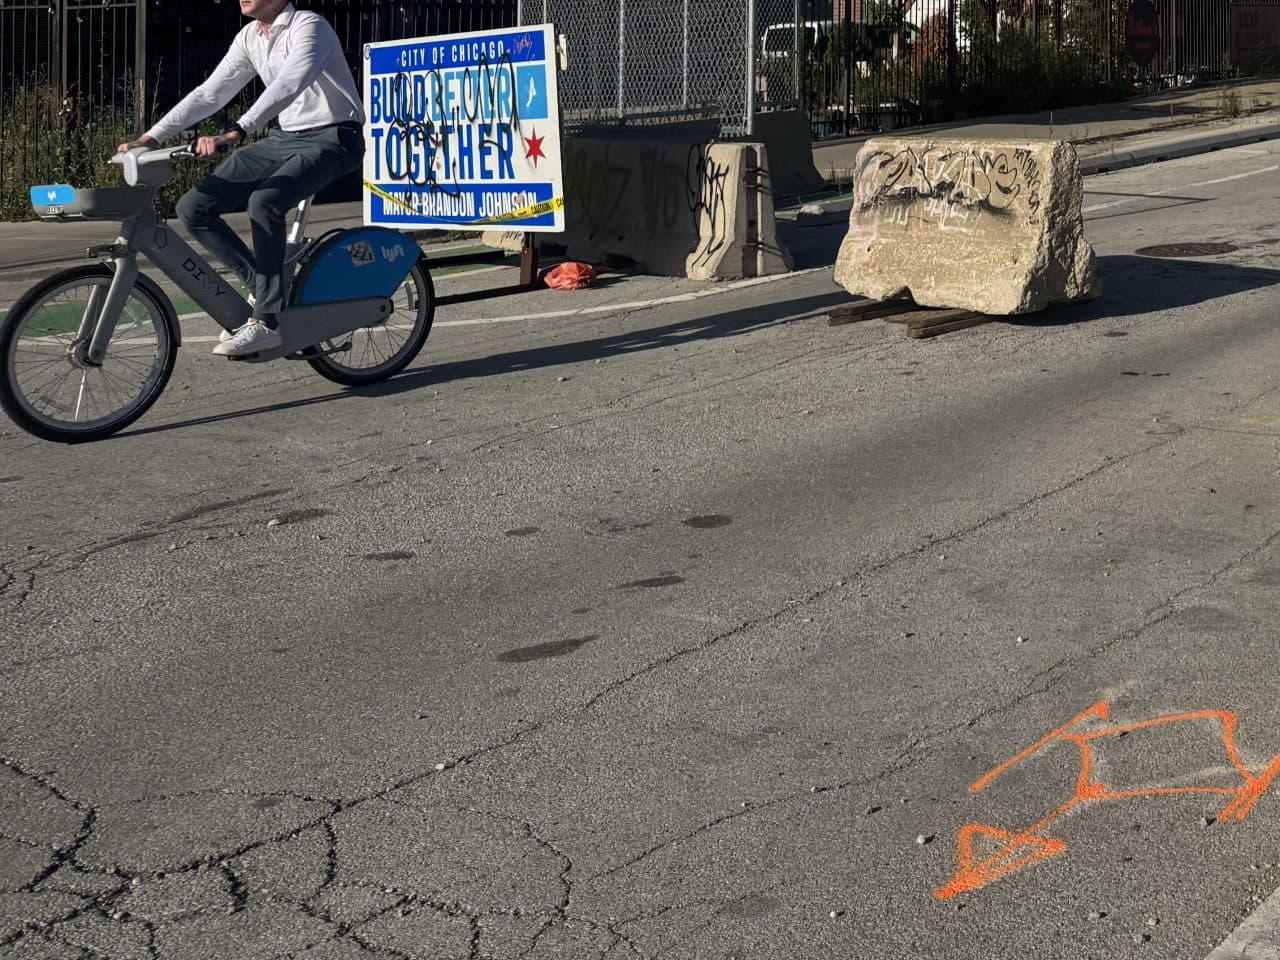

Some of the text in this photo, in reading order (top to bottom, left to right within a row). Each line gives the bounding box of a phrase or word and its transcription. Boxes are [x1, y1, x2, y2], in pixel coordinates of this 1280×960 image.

[401, 48, 425, 67] CITY
[433, 46, 445, 64] OF
[452, 40, 504, 62] CHICAGO
[370, 70, 512, 124] BUILD BETTER
[371, 123, 515, 180] TOGETHER
[382, 191, 419, 216] MAYOR
[422, 191, 475, 217] BRANDON
[479, 191, 537, 218] JOHNSON
